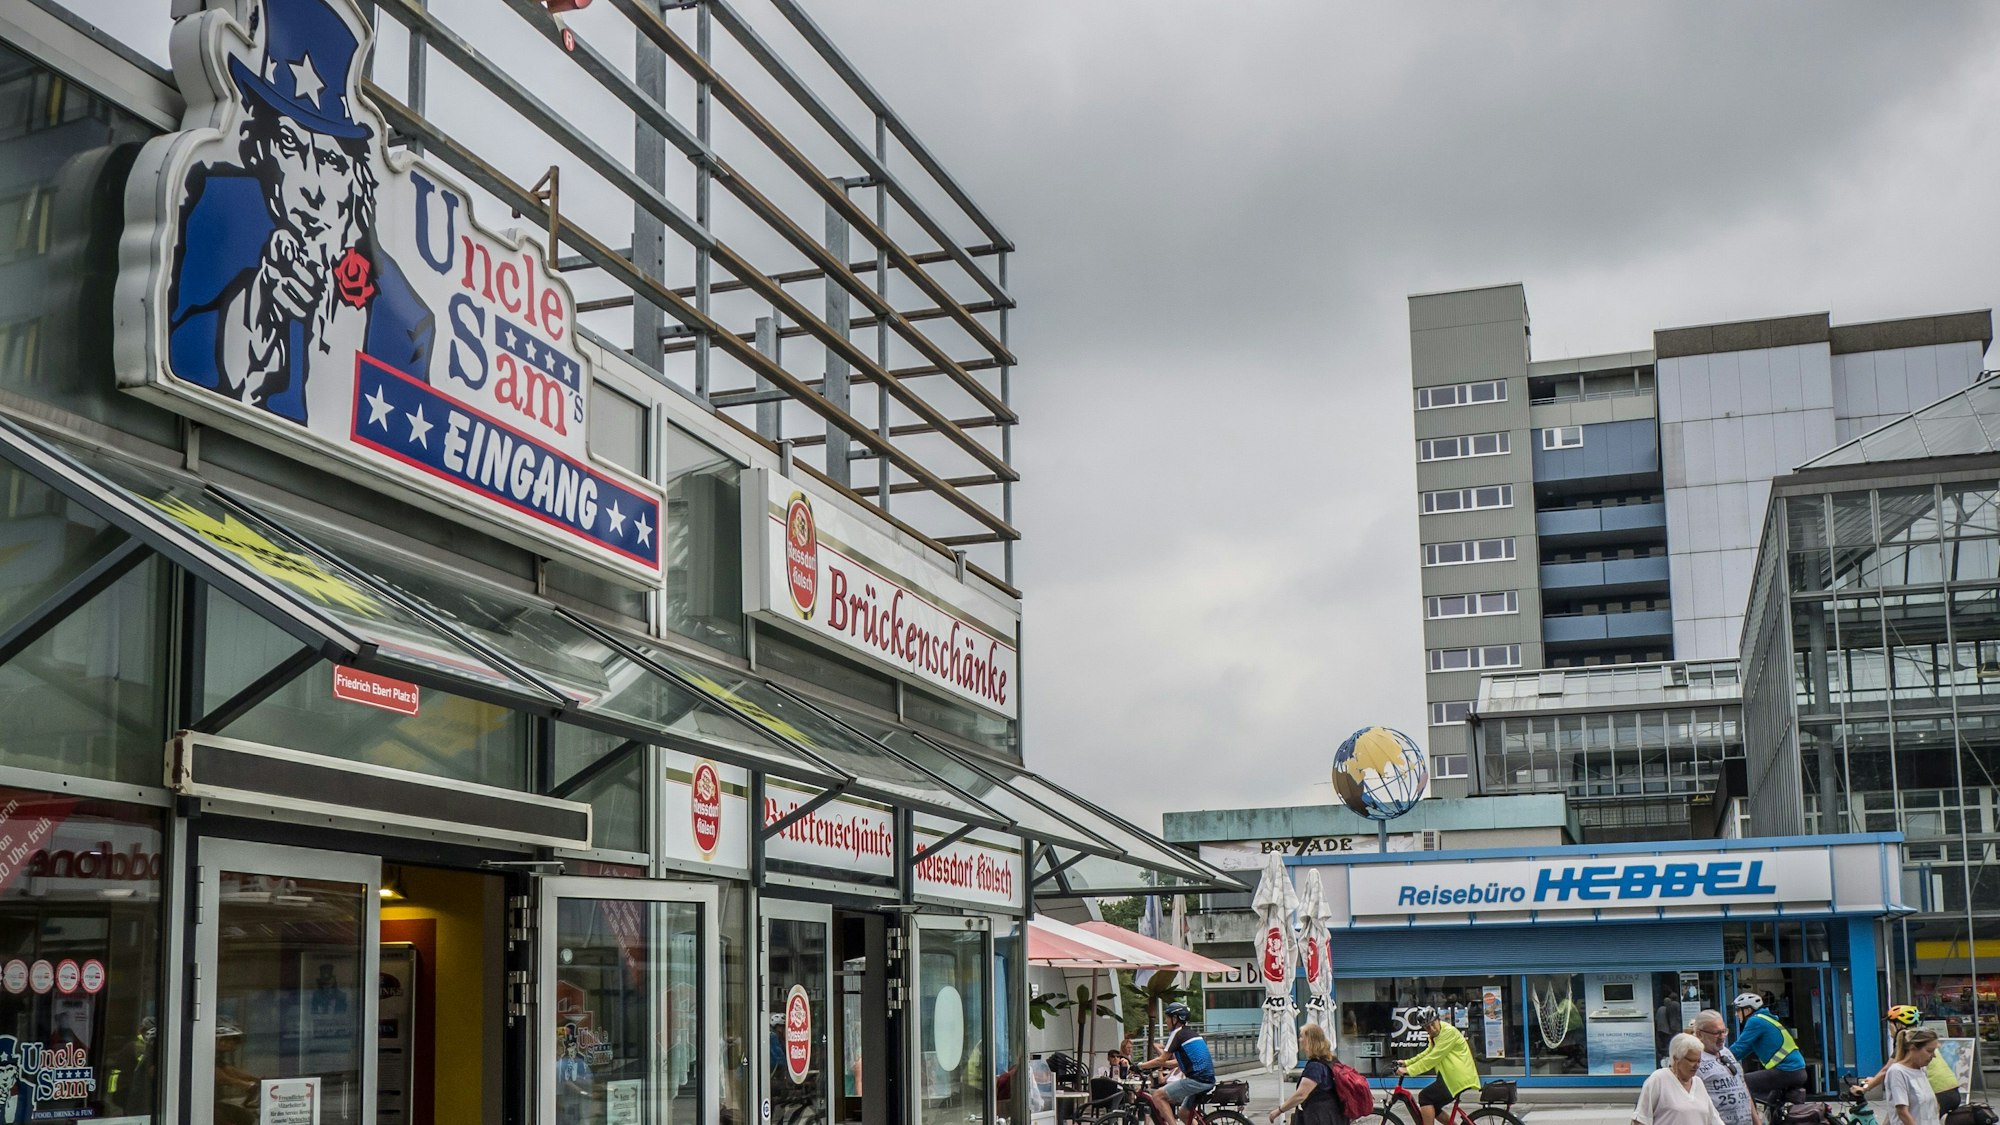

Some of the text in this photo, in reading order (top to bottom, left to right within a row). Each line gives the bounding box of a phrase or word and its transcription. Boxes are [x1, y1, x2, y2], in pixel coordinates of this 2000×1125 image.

[410, 170, 564, 341] Uncle
[448, 292, 584, 437] Sam's
[443, 409, 598, 531] EINGANG
[828, 565, 1007, 706] Brückenschänke
[337, 674, 416, 704] Friedrich Ebert Platz 9
[7, 842, 29, 866] Uhr
[28, 816, 52, 844] früh
[915, 842, 1012, 902] Reissdorf Kölsch
[1399, 860, 1776, 906] Reisebüro HEBBEL
[20, 1042, 86, 1075] Uncle
[37, 1069, 96, 1101] Sam's
[54, 1110, 75, 1118] DRINKS
